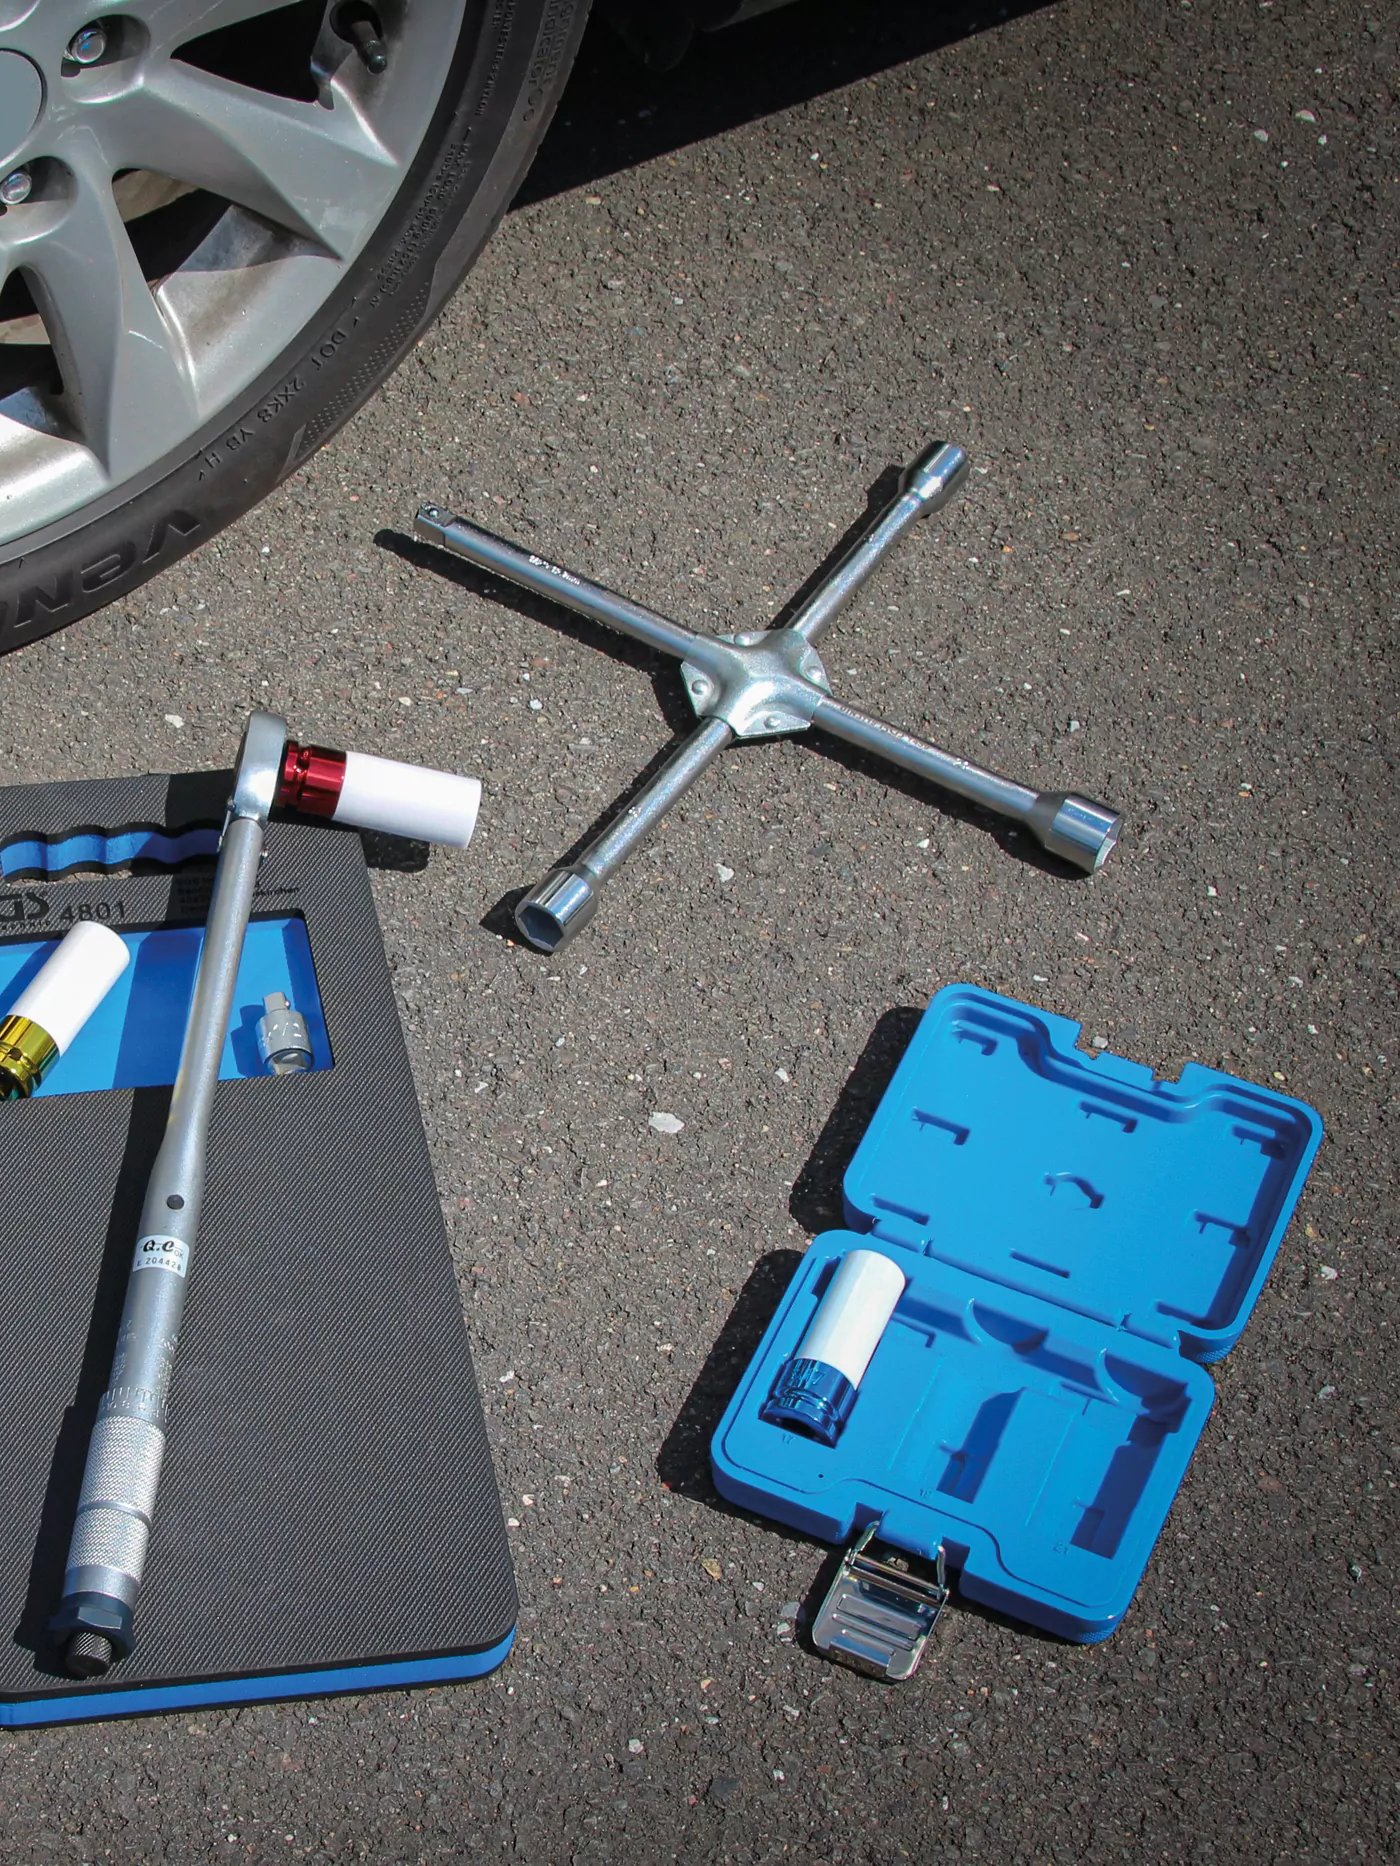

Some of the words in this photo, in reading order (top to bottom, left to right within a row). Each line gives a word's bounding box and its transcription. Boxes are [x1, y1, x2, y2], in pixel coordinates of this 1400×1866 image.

[306, 327, 351, 371] DOT
[254, 375, 305, 425] 2XK8
[223, 423, 254, 454] YB
[203, 450, 223, 470] H
[59, 900, 126, 923] 4801
